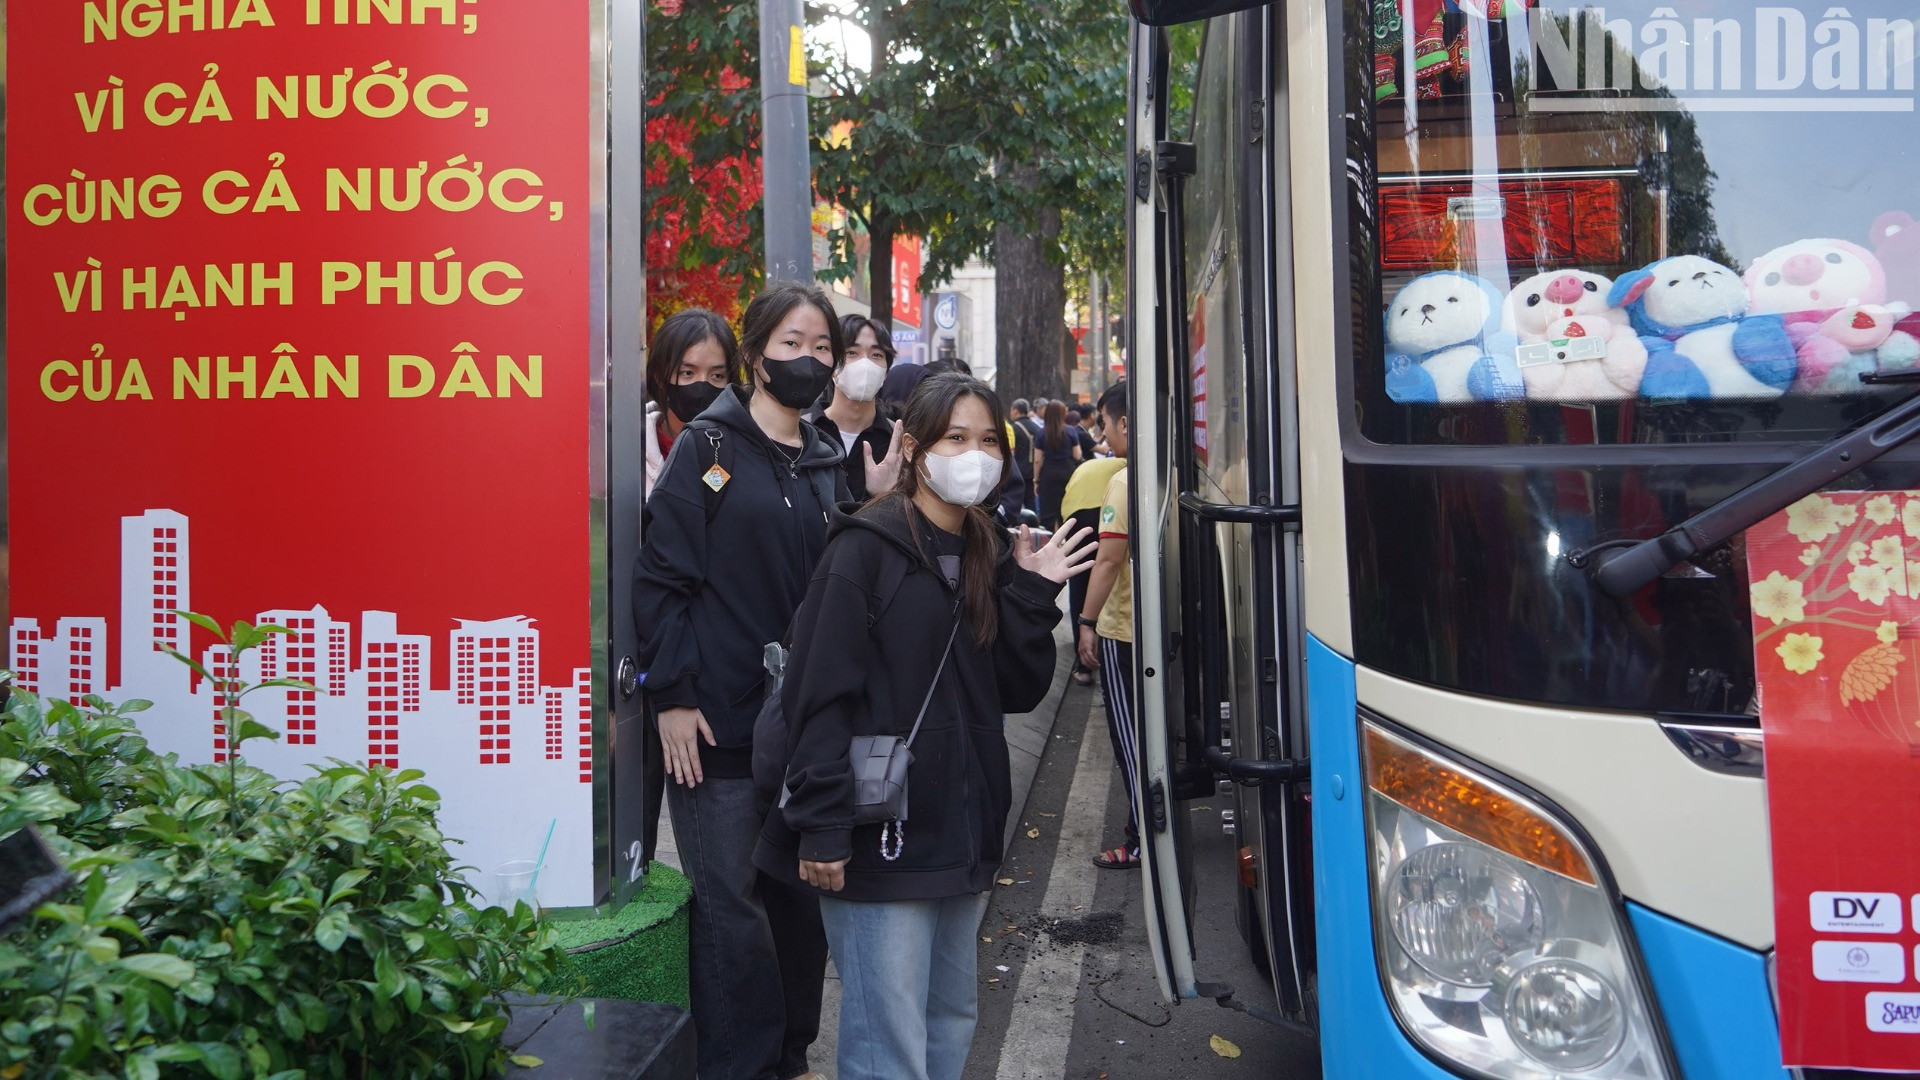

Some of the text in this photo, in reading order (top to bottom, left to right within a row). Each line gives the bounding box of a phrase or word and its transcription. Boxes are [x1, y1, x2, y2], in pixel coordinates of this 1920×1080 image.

[75, 60, 489, 132] VÌ CẢ NƯỚC,
[24, 152, 563, 225] CÙNG CẢ NƯỚC,
[54, 247, 524, 321] VÌ HẠNH PHÚC
[41, 342, 543, 401] CỦA NHÂN DÂN
[1833, 898, 1880, 919] DV
